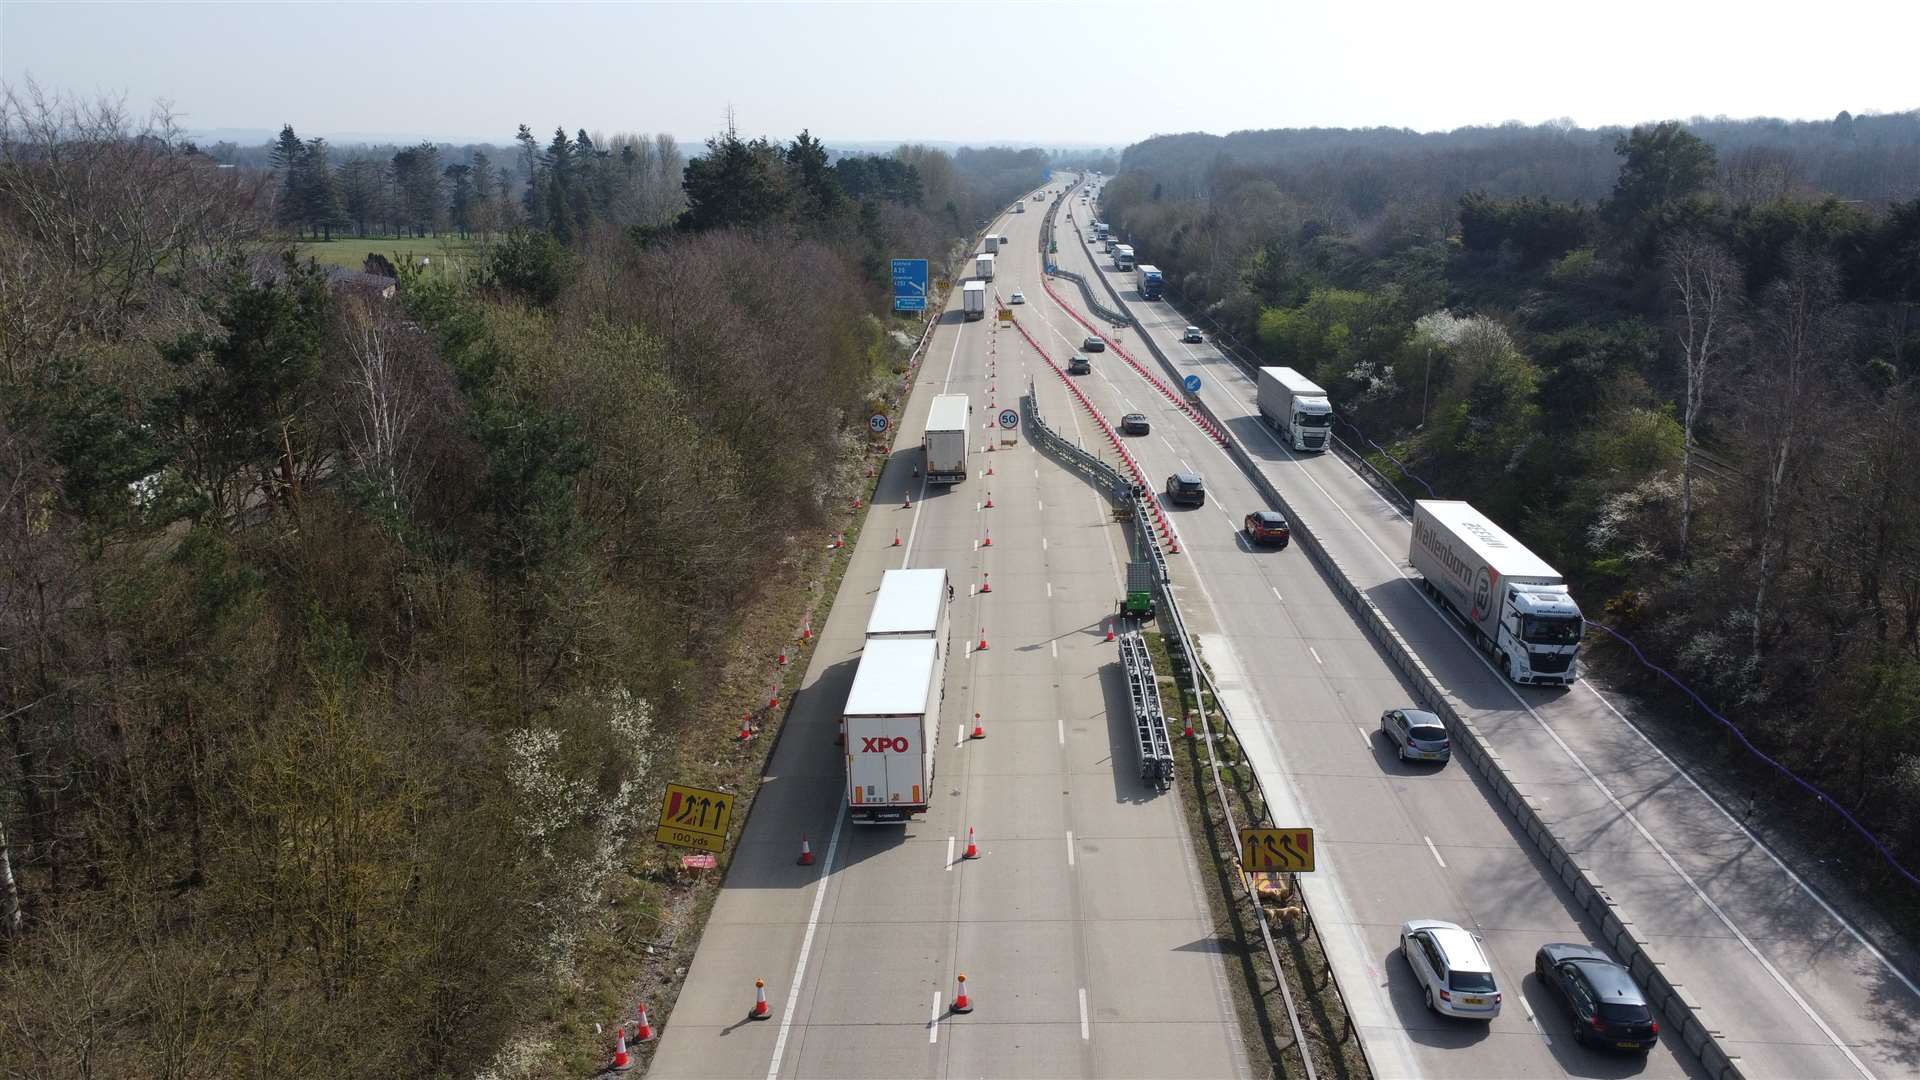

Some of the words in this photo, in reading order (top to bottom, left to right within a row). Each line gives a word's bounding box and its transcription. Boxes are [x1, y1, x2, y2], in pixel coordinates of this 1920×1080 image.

[871, 418, 886, 428] 50
[1002, 415, 1016, 424] 50
[1415, 518, 1473, 586] Wallenborn
[861, 736, 909, 753] XPO
[673, 832, 690, 842] 100
[692, 837, 708, 846] yds
